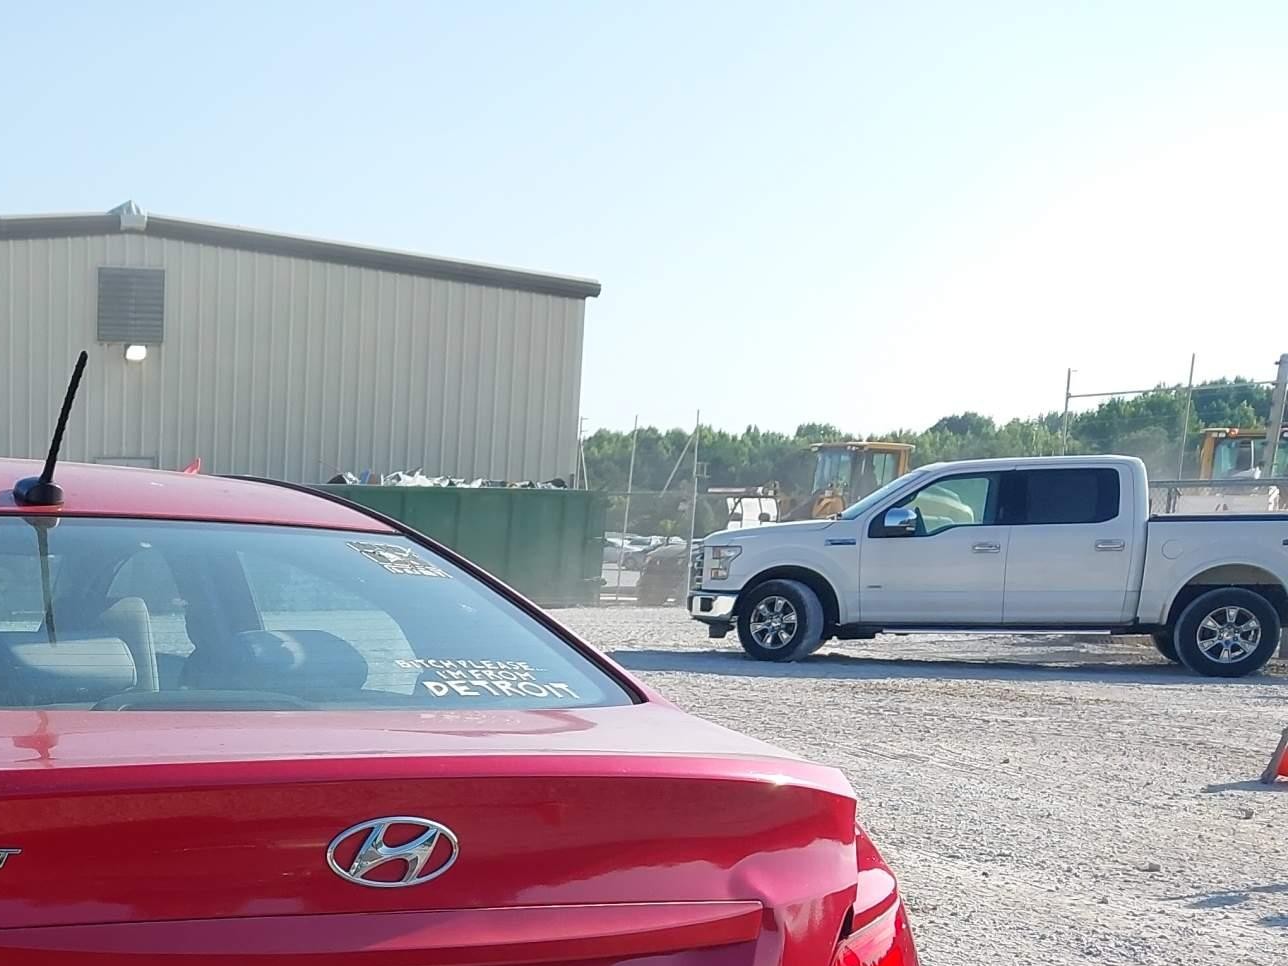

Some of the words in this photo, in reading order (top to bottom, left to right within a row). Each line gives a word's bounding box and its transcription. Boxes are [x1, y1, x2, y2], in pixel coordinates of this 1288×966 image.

[395, 659, 458, 669] BITCH
[436, 669, 468, 680] I'M
[469, 670, 537, 681] FROM
[422, 680, 580, 699] DETROIT
